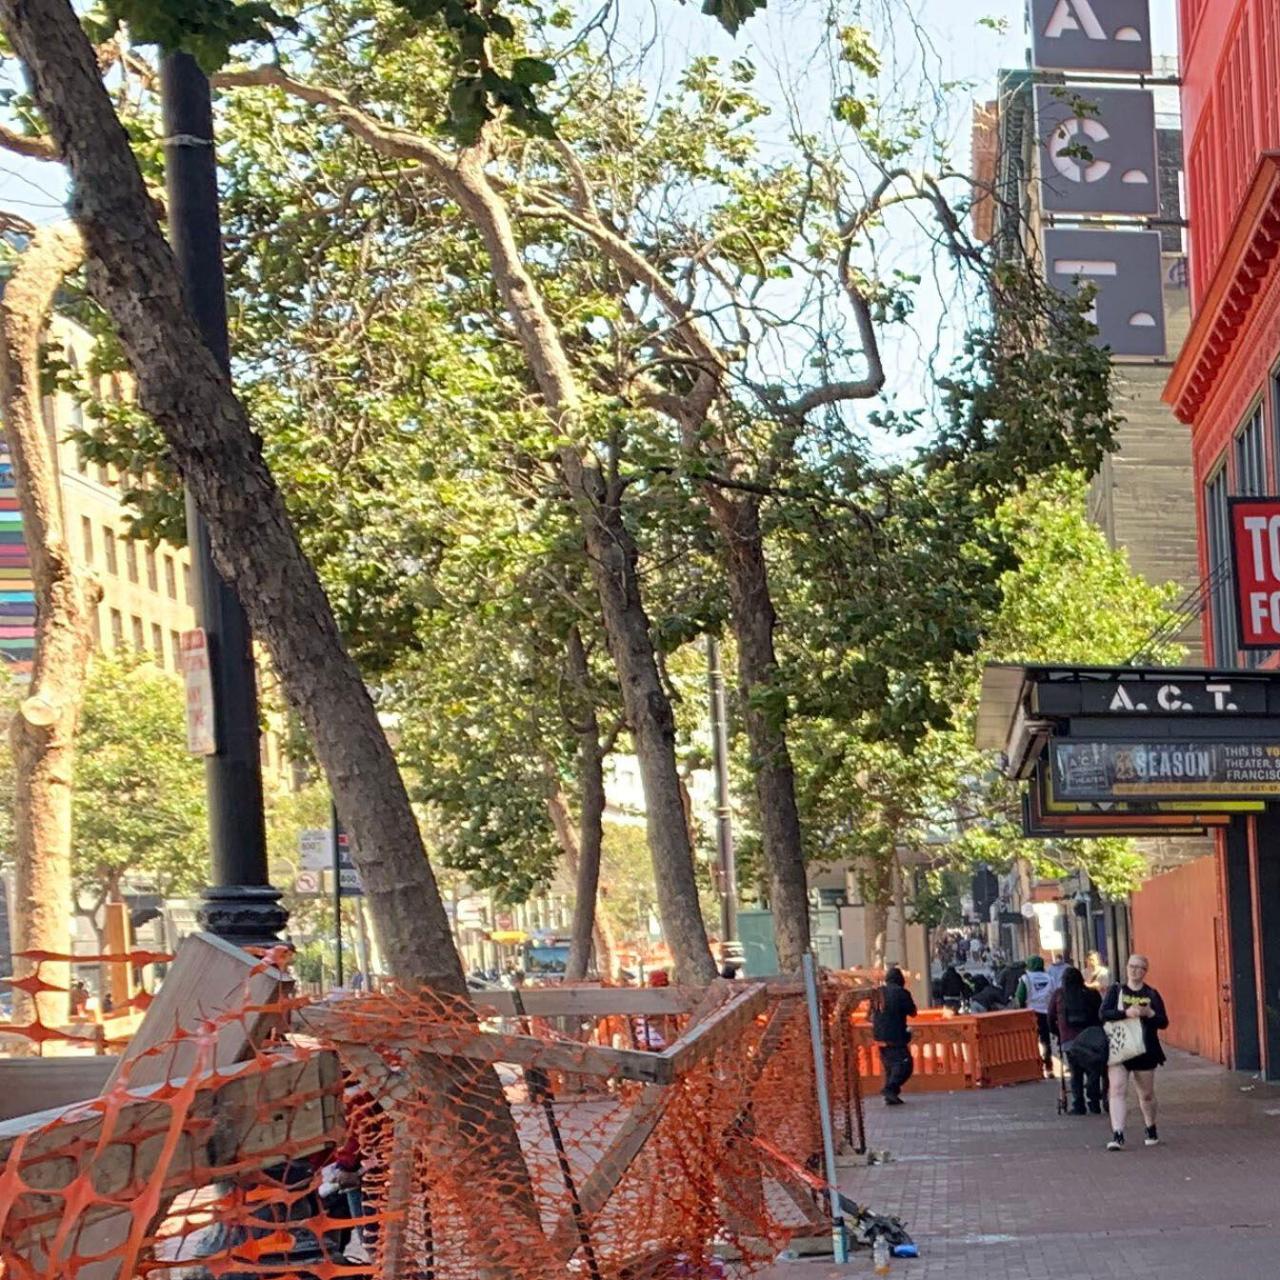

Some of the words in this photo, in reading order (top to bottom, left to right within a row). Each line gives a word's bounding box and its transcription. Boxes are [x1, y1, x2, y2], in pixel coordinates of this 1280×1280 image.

[1109, 684, 1238, 711] A.C.T.
[1225, 745, 1249, 757] THIS
[1252, 745, 1263, 757] IS
